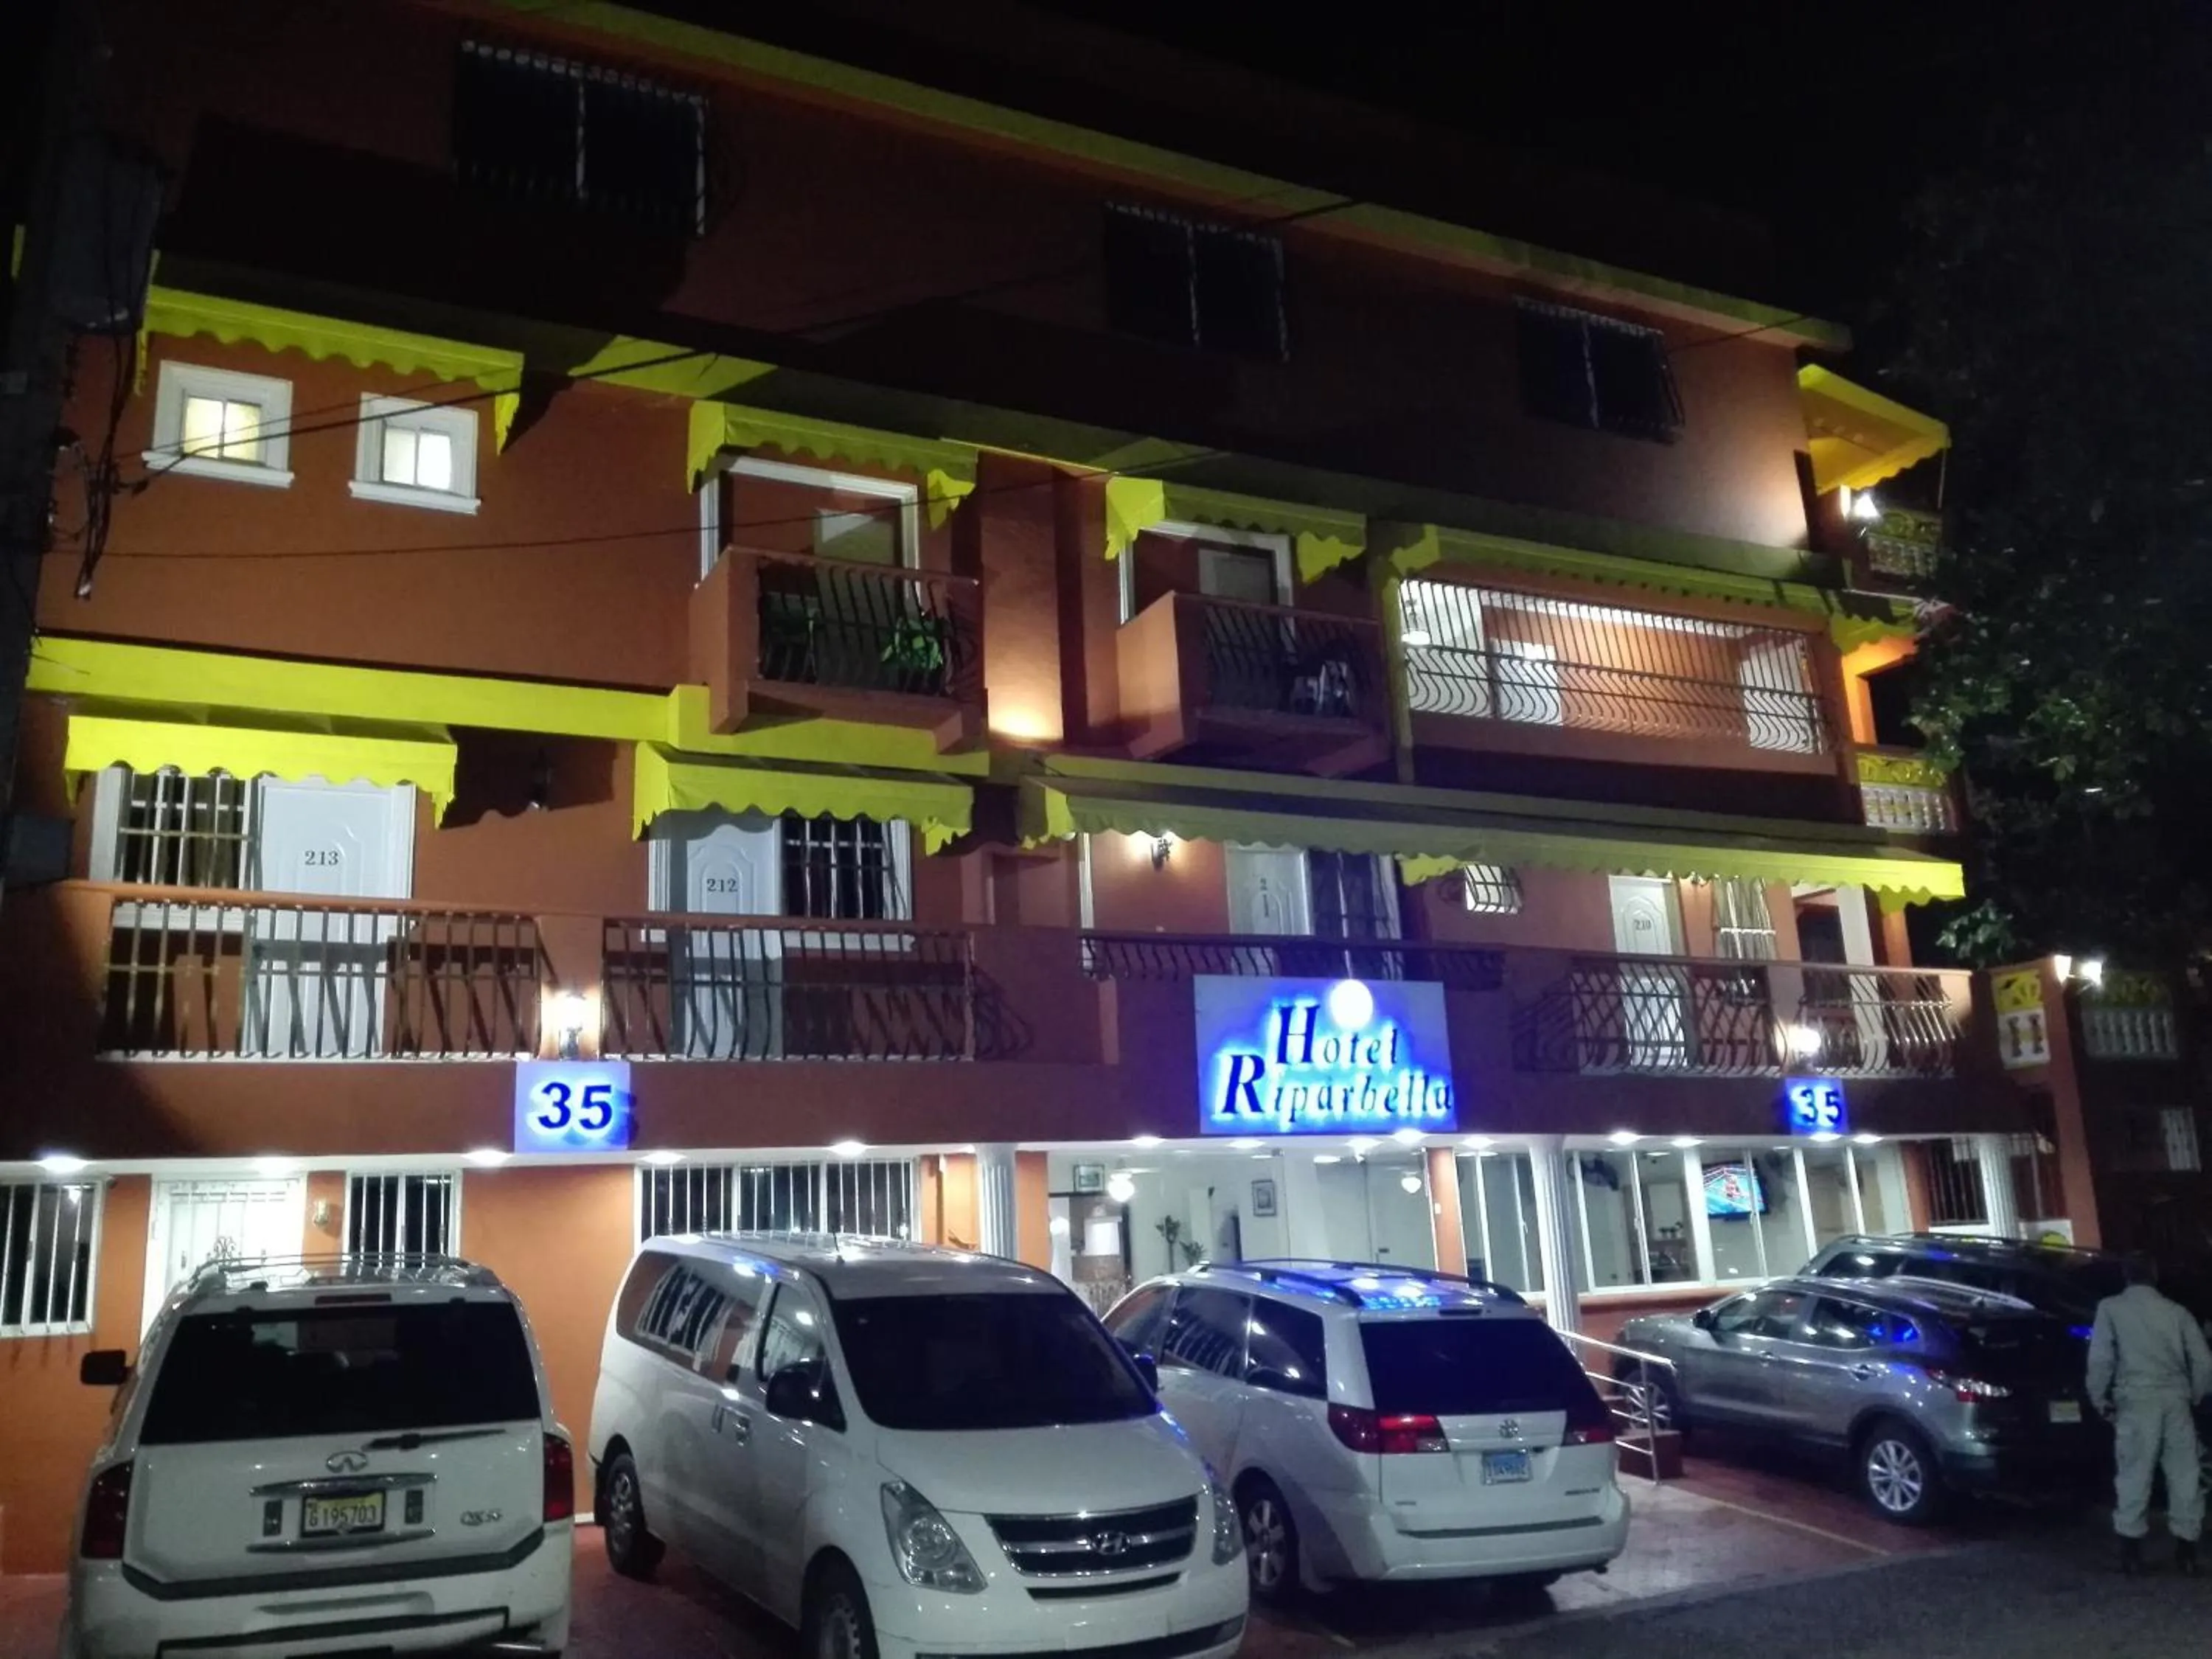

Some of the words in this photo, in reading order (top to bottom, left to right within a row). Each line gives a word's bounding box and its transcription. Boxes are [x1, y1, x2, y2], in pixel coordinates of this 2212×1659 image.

[304, 850, 339, 866] 213
[706, 877, 738, 893] 212
[1276, 1003, 1399, 1065] Hotel
[538, 1081, 613, 1130] 35
[1221, 1054, 1452, 1123] Riparbella
[1799, 1088, 1842, 1125] 35
